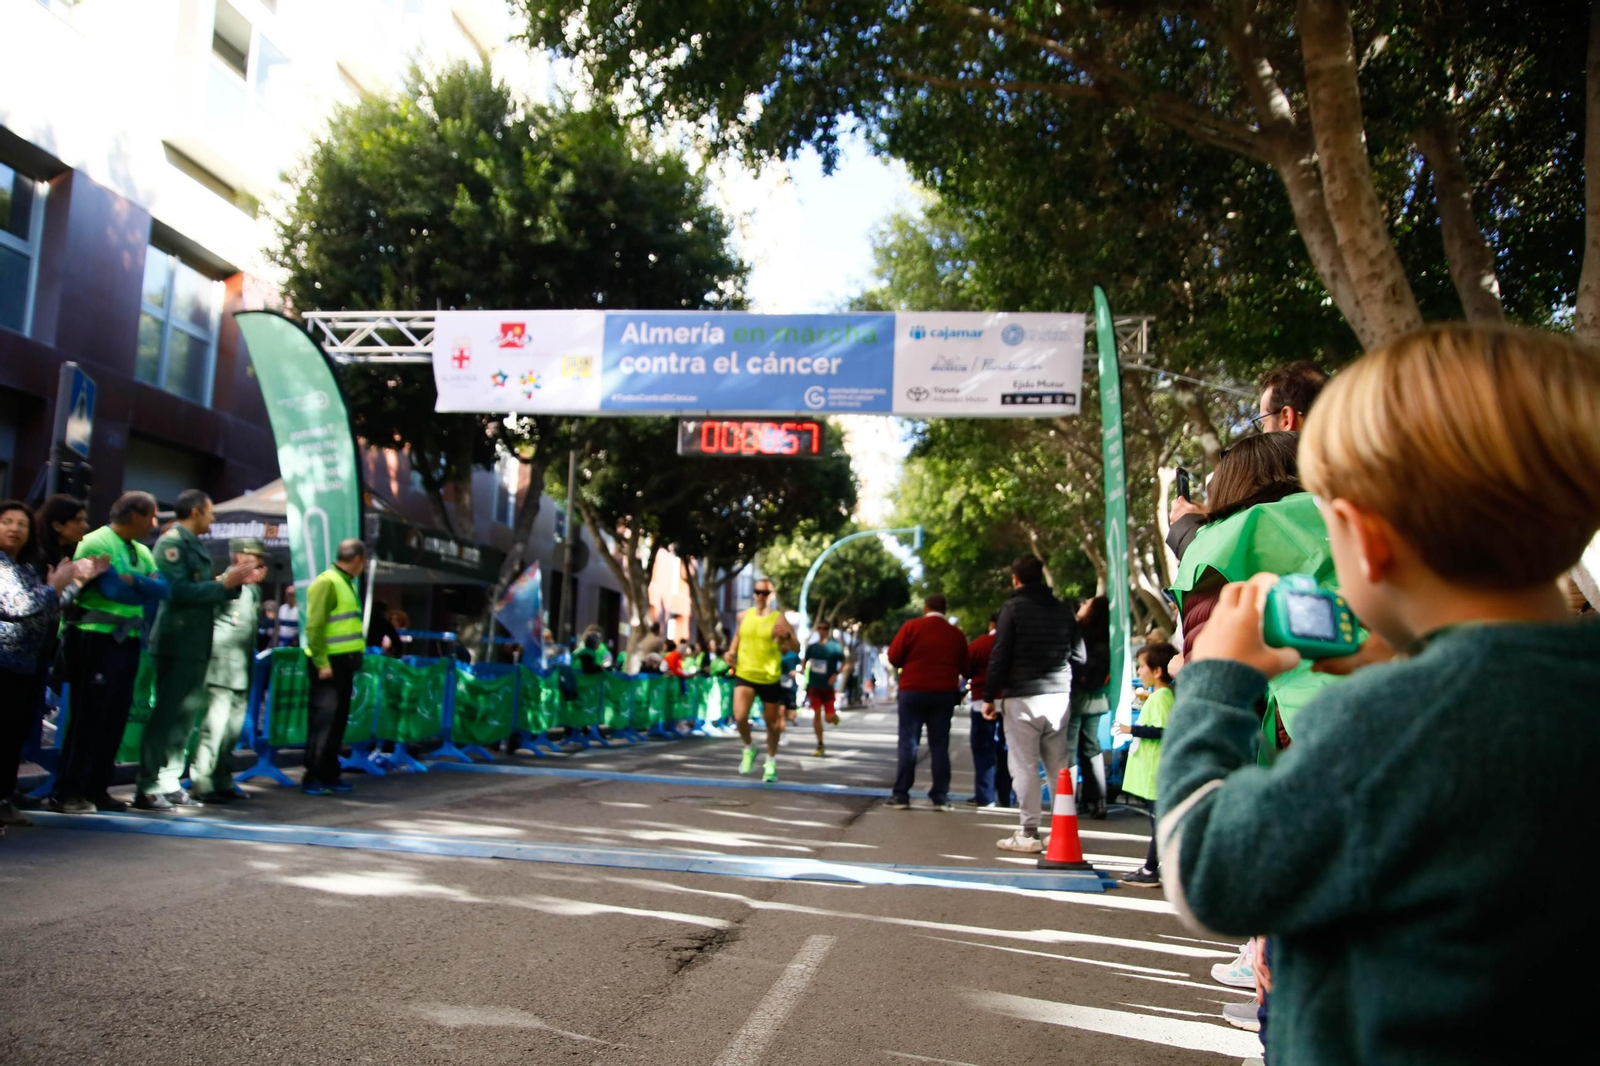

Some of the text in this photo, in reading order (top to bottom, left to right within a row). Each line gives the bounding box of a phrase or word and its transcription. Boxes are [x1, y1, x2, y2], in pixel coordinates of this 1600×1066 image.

[620, 321, 877, 345] Almería en marcha
[930, 326, 984, 341] cajamar
[619, 352, 706, 375] contra
[713, 351, 740, 374] el
[746, 351, 842, 375] cáncer
[1036, 379, 1064, 389] Motor
